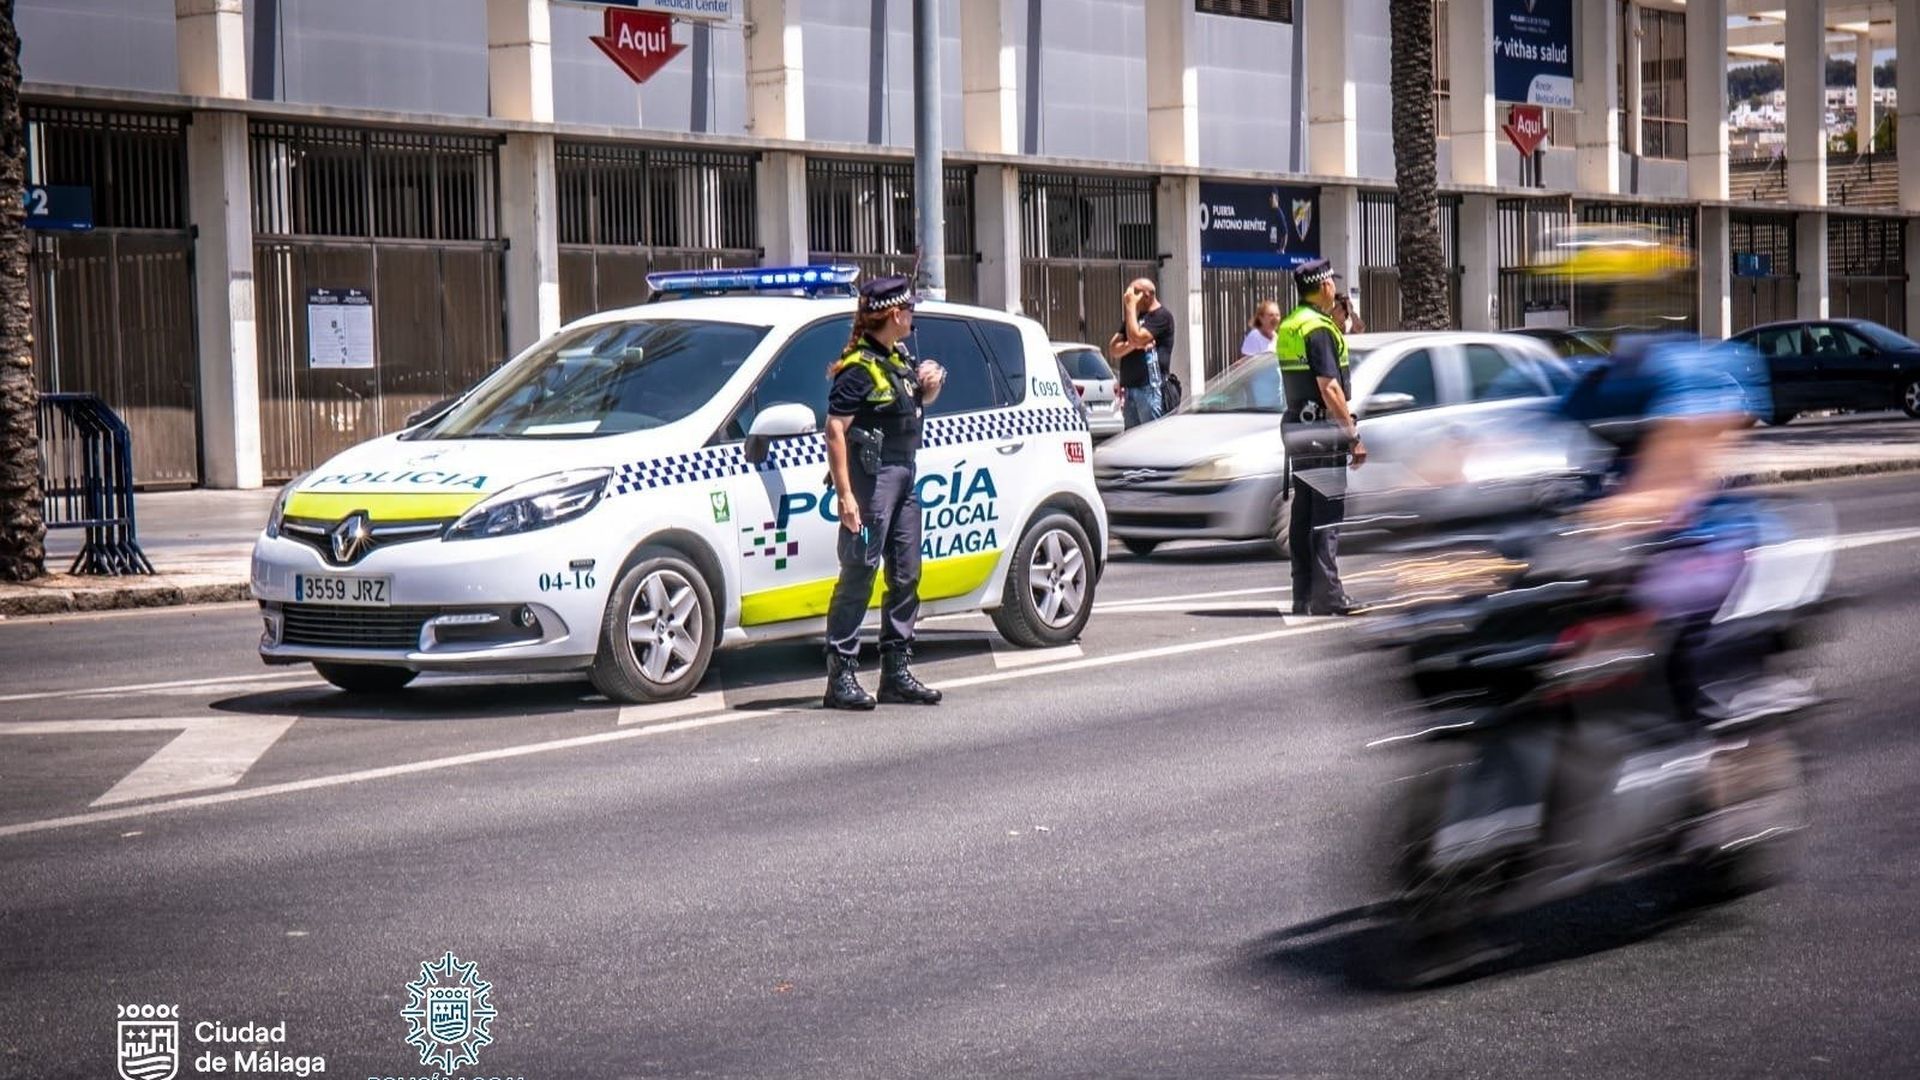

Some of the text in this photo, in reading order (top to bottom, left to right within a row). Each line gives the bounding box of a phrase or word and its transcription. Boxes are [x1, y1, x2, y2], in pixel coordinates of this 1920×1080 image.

[695, 0, 728, 12] Center
[618, 22, 666, 57] Aquí
[1504, 38, 1567, 63] vithas salud
[1212, 205, 1235, 216] PUERTA
[1212, 219, 1243, 231] ANTONIO
[1038, 381, 1061, 397] 092
[924, 501, 999, 531] LOCAL
[921, 527, 998, 560] ÁLAGA
[304, 579, 386, 602] 3559 JRZ
[539, 568, 596, 592] 04-16
